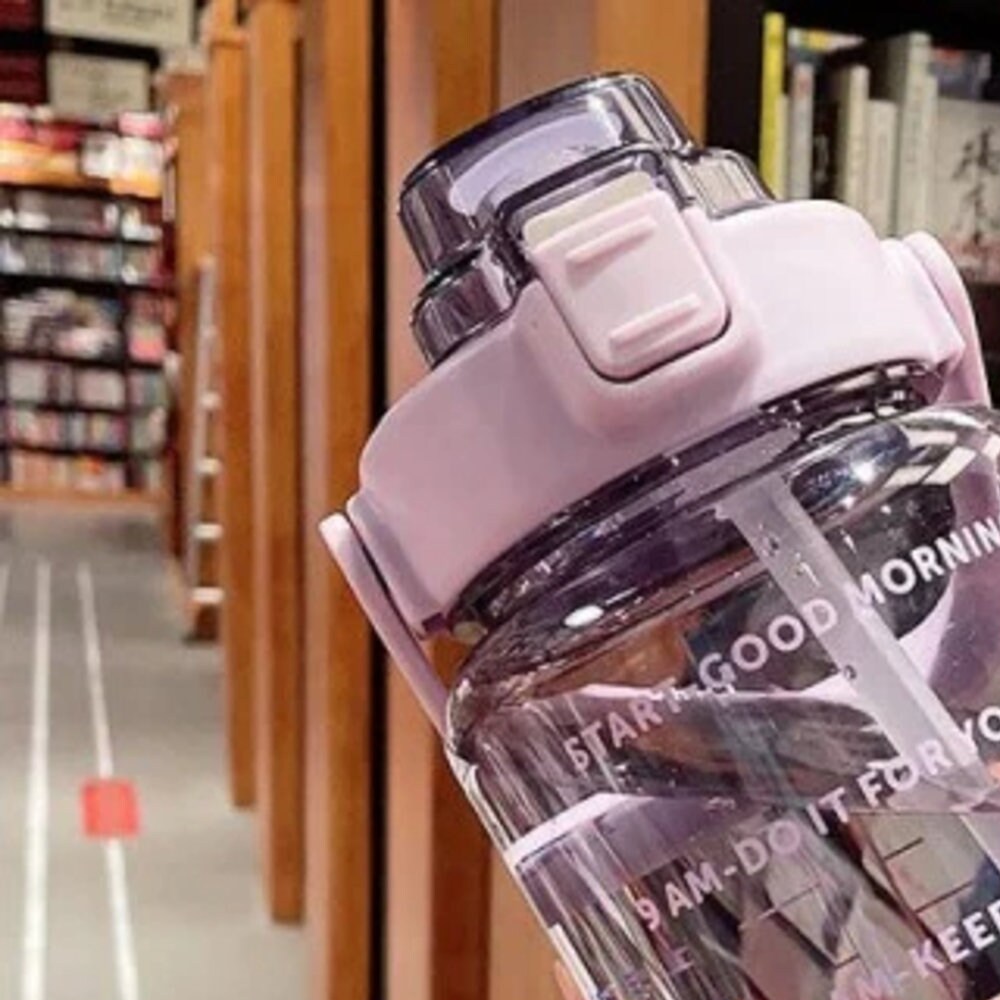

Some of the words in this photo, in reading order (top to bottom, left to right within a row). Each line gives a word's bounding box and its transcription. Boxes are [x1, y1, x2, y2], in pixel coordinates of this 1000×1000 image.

[633, 896, 661, 932] 9
[665, 818, 801, 918] AM-DO
[807, 785, 849, 836] IT
[856, 739, 953, 808] FOR
